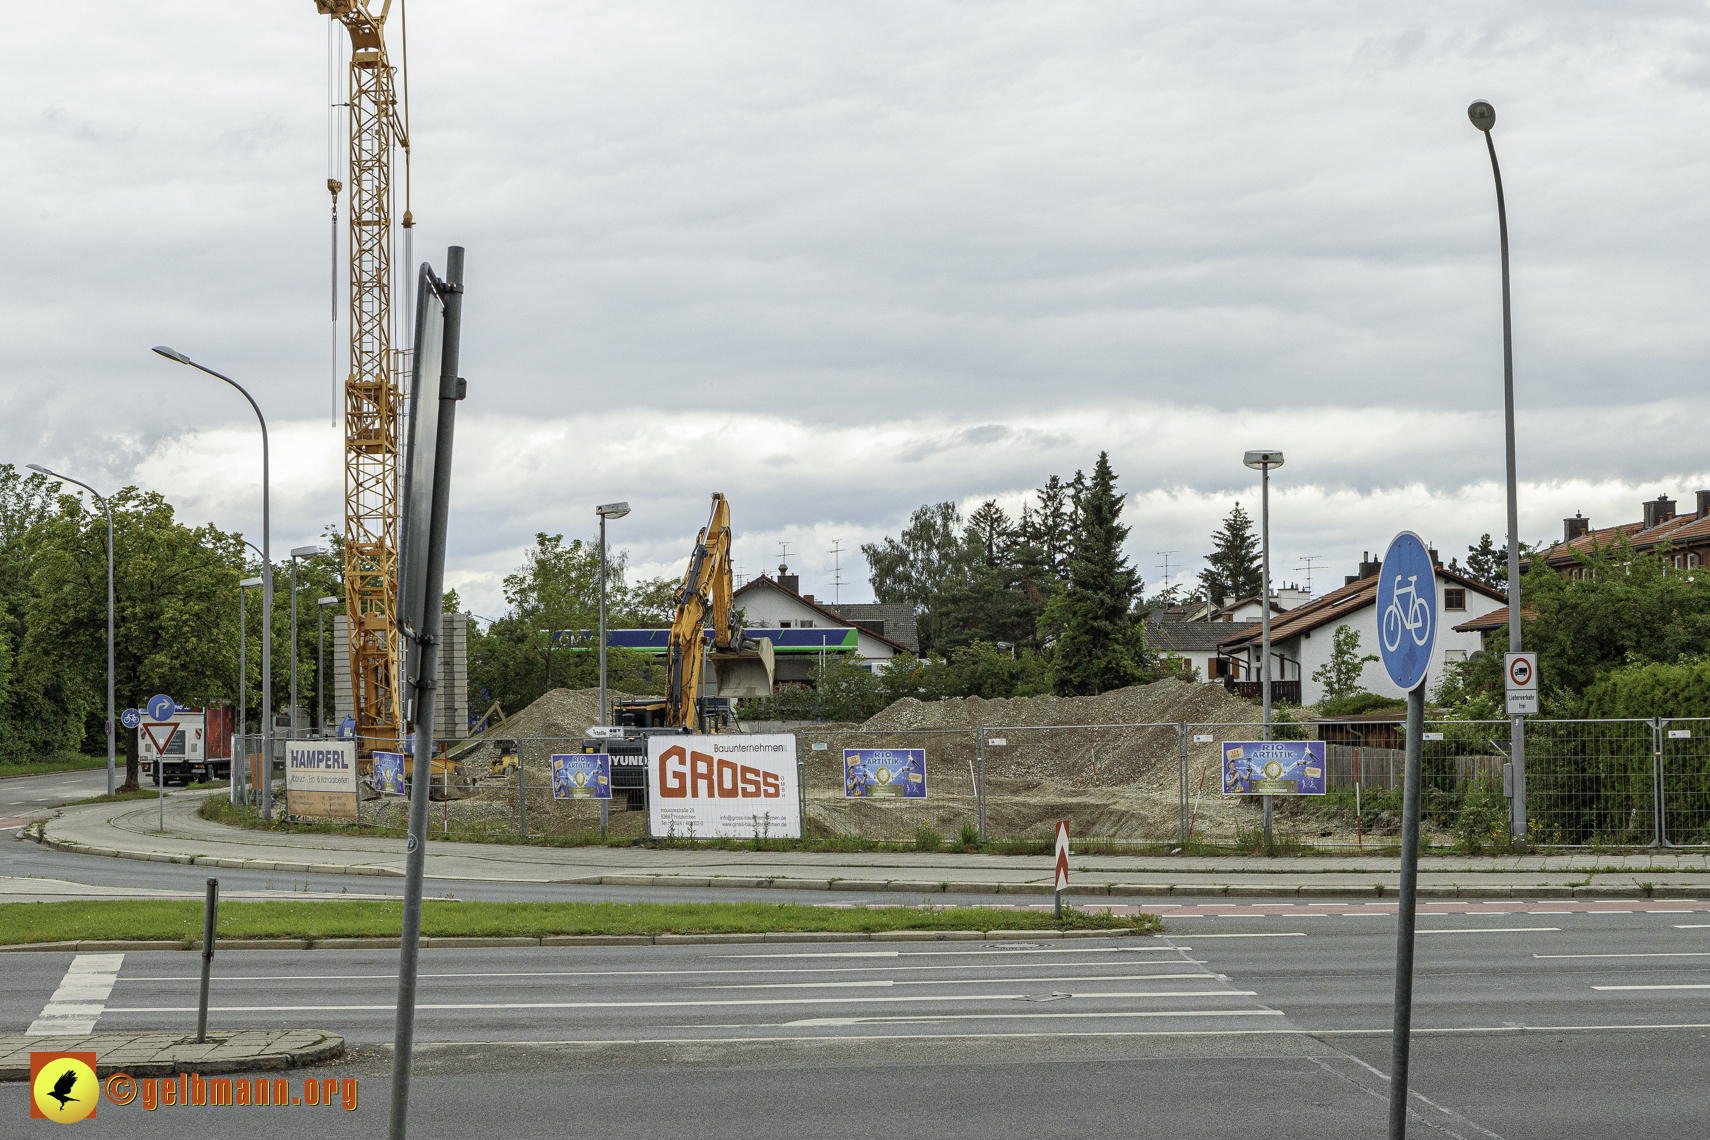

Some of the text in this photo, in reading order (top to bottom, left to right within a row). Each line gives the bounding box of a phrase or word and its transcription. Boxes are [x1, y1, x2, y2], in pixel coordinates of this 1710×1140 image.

[713, 743, 784, 753] Bauunternehmen
[291, 749, 349, 769] HAMPERL
[609, 755, 648, 766] YUND
[658, 745, 780, 798] GROSS
